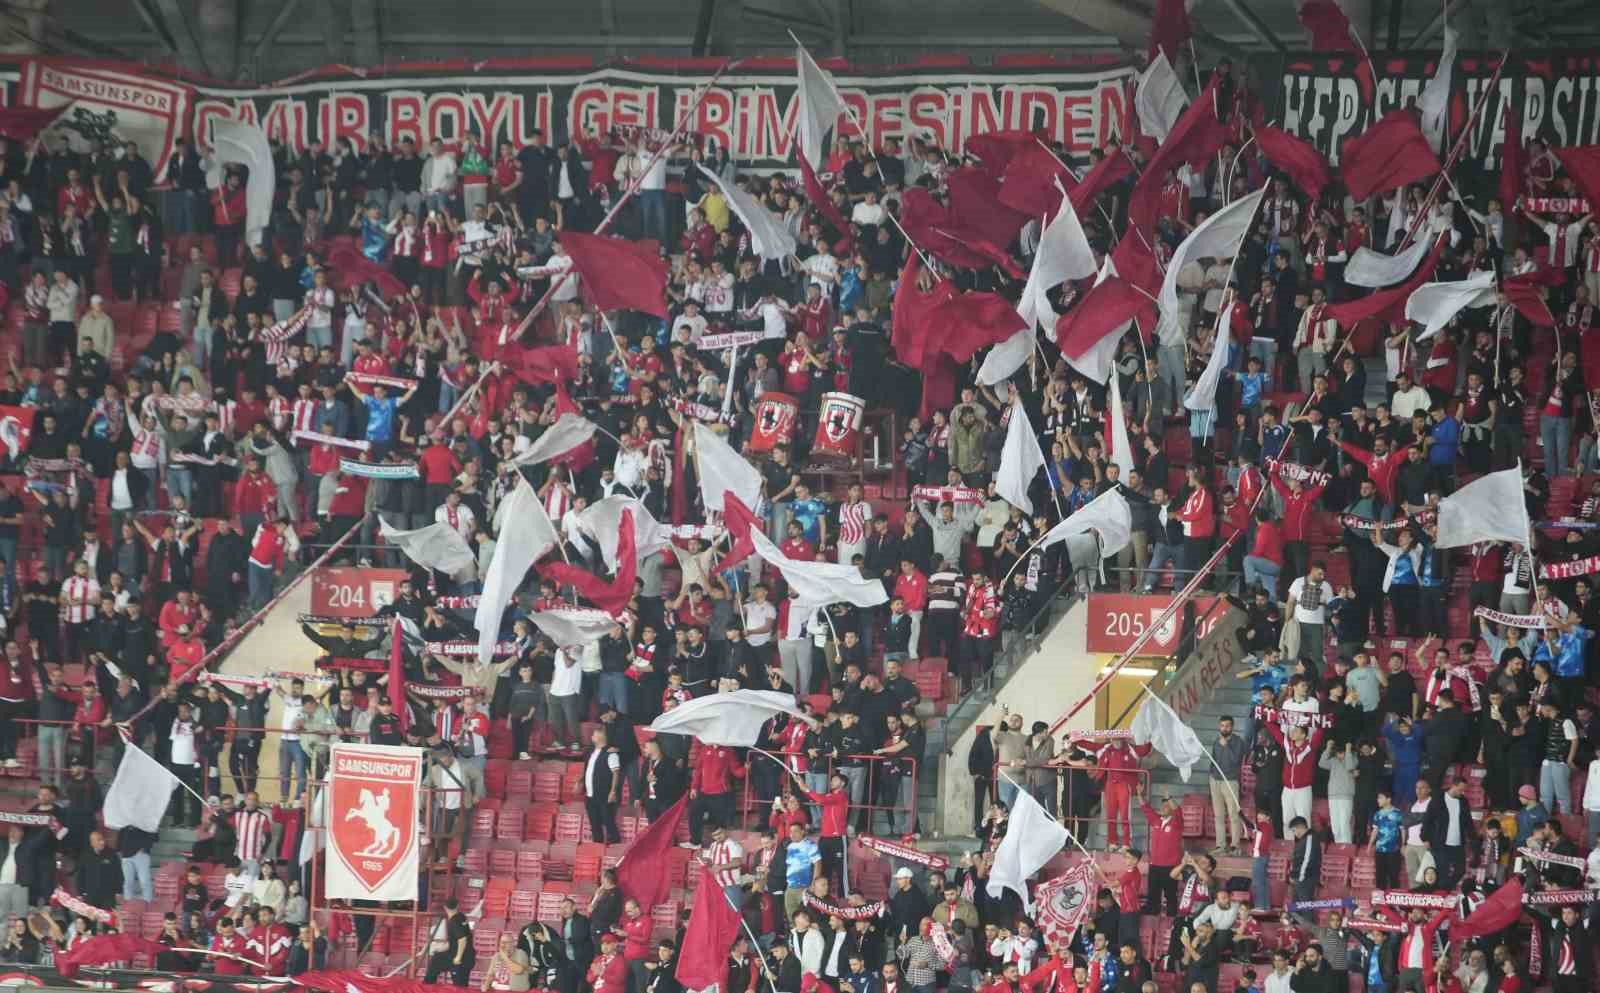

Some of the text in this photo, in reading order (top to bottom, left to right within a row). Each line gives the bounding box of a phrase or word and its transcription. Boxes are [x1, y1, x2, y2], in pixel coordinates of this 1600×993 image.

[44, 71, 169, 110] SAMSUNSPOR
[387, 89, 553, 155] BOYU
[328, 584, 366, 608] 204
[1105, 612, 1145, 637] 205
[338, 758, 412, 777] SAMSUNSPOR
[362, 860, 383, 871] 1965
[1384, 893, 1444, 907] SAMSUNSPOR
[1530, 892, 1595, 904] SAMSUNSPOR
